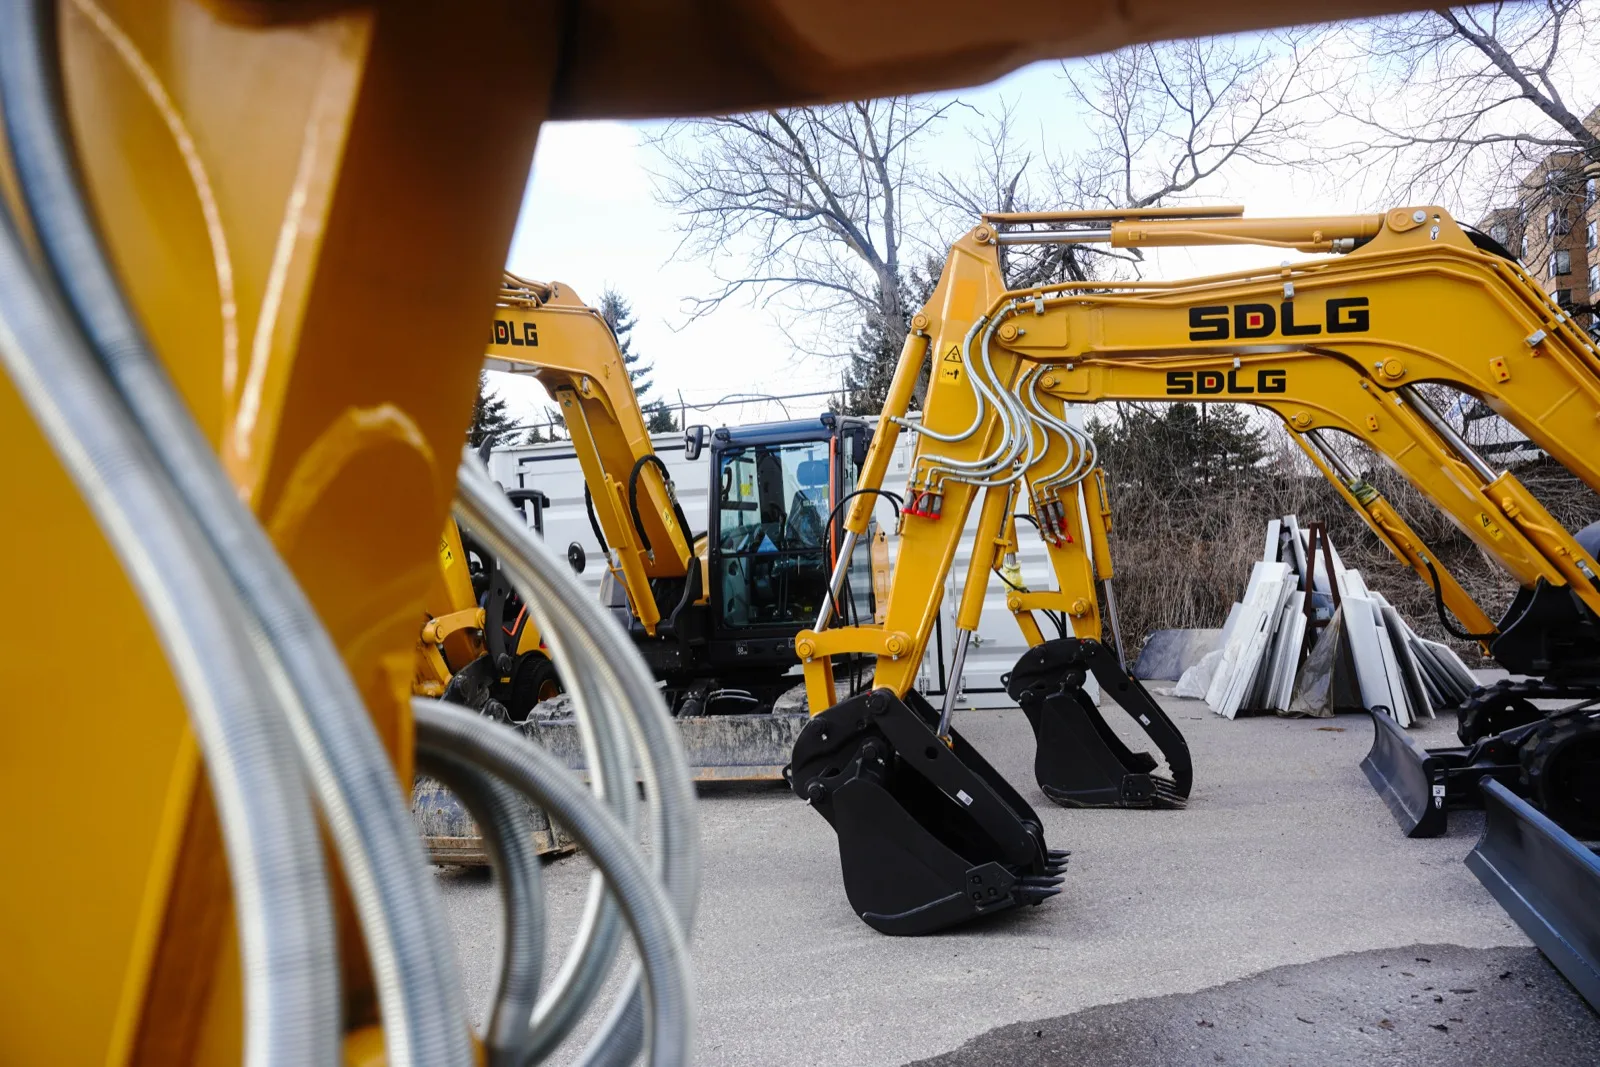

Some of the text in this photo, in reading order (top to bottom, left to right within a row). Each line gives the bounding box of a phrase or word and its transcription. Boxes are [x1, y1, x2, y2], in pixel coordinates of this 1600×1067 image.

[489, 319, 539, 346] DLG
[1189, 297, 1369, 341] SDLG
[1166, 370, 1286, 394] SDLG
